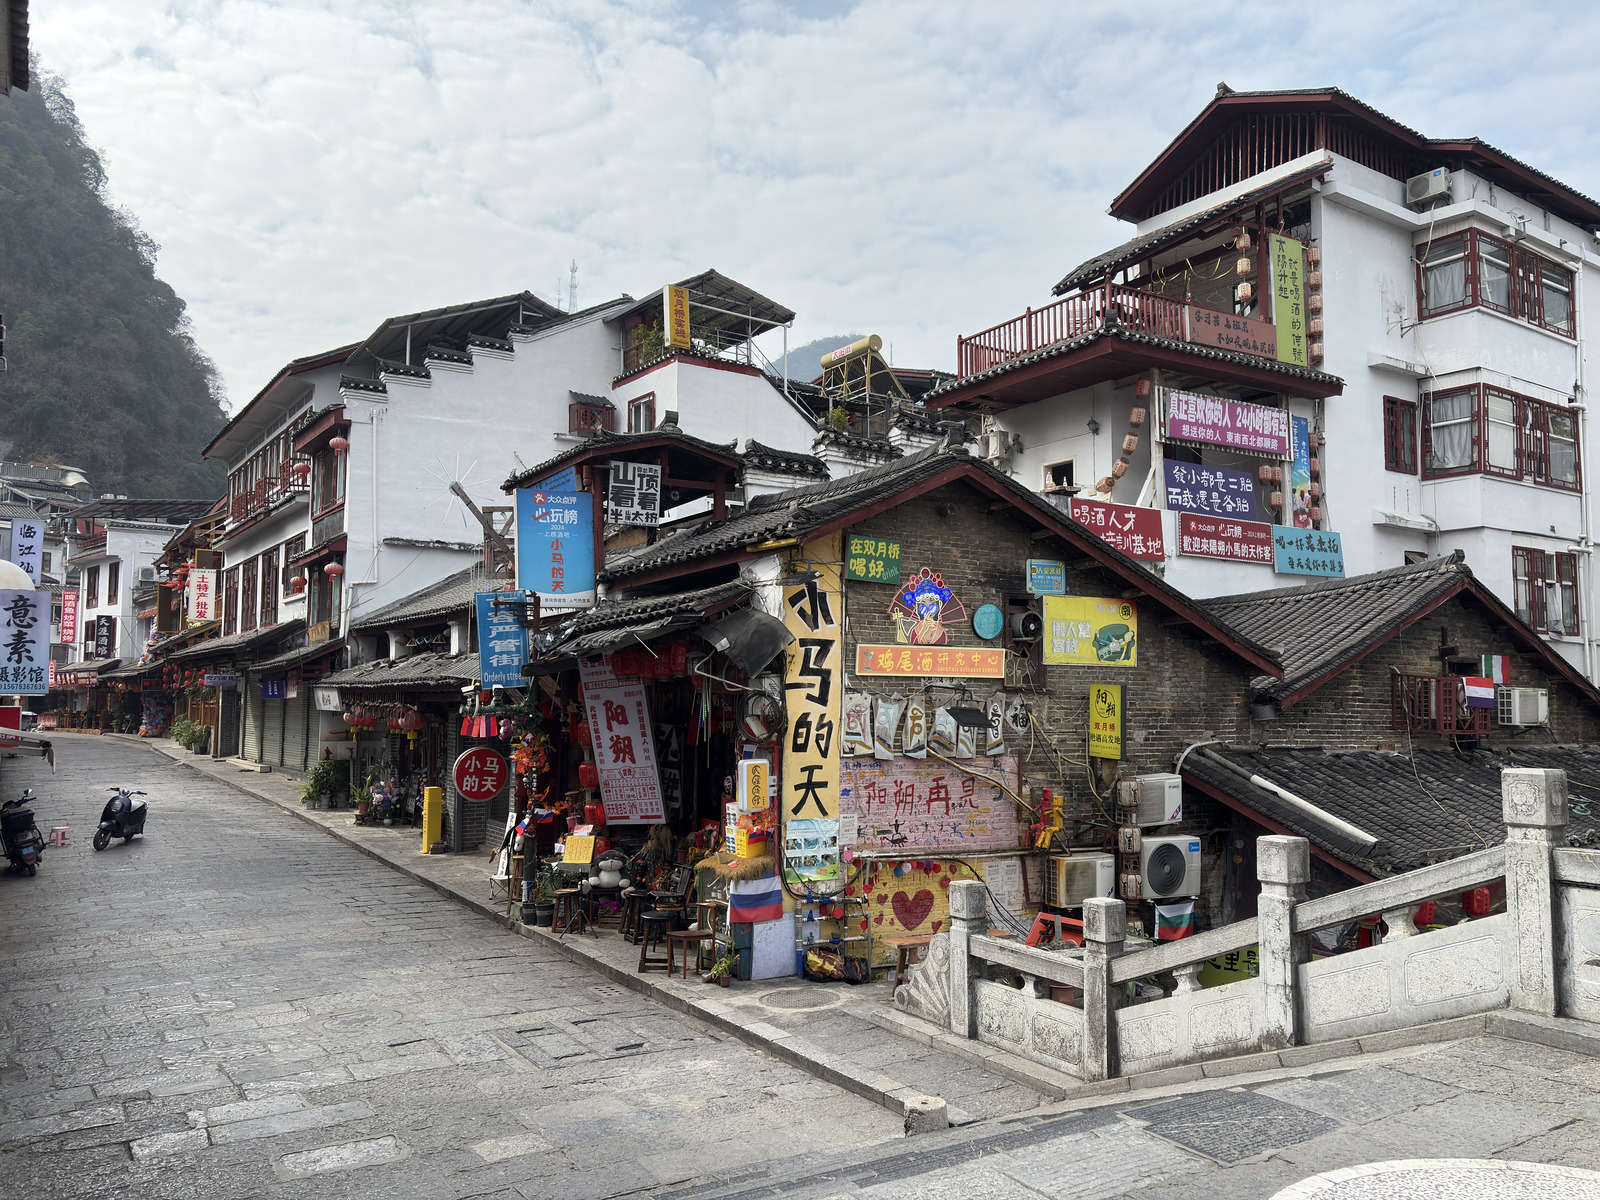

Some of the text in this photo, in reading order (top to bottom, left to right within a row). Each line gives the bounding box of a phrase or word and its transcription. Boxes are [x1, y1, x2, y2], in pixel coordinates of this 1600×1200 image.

[1169, 391, 1288, 437] 真正喜欢你的人 24小时都有空
[1181, 423, 1222, 442] 想送你的人
[1226, 431, 1279, 451] 東南西北都順路
[1172, 465, 1253, 492] 發小都是二胎
[547, 495, 577, 504] 大众点评
[534, 507, 578, 525] 必玩榜
[1073, 505, 1137, 532] 喝酒人才
[1197, 523, 1216, 532] 大众点评
[1218, 523, 1242, 539] 必玩榜
[850, 538, 901, 560] 在双月桥
[550, 538, 565, 593] 小马的天
[850, 557, 885, 578] 喝好
[882, 565, 899, 581] drink
[195, 574, 209, 619] 土特产批发
[3, 594, 38, 665] 意素
[62, 594, 76, 642] 啤酒鱼 炒菜 烧烤
[97, 616, 110, 656] 天涯酒馆
[1051, 638, 1079, 654] 客栈
[483, 672, 506, 683] Orderly
[785, 580, 836, 817] 小马的天
[1096, 688, 1116, 717] 阳朔
[602, 699, 636, 765] 阳朔
[1094, 722, 1116, 732] 双月桥
[464, 755, 500, 774] 小马
[462, 775, 497, 793] 的天
